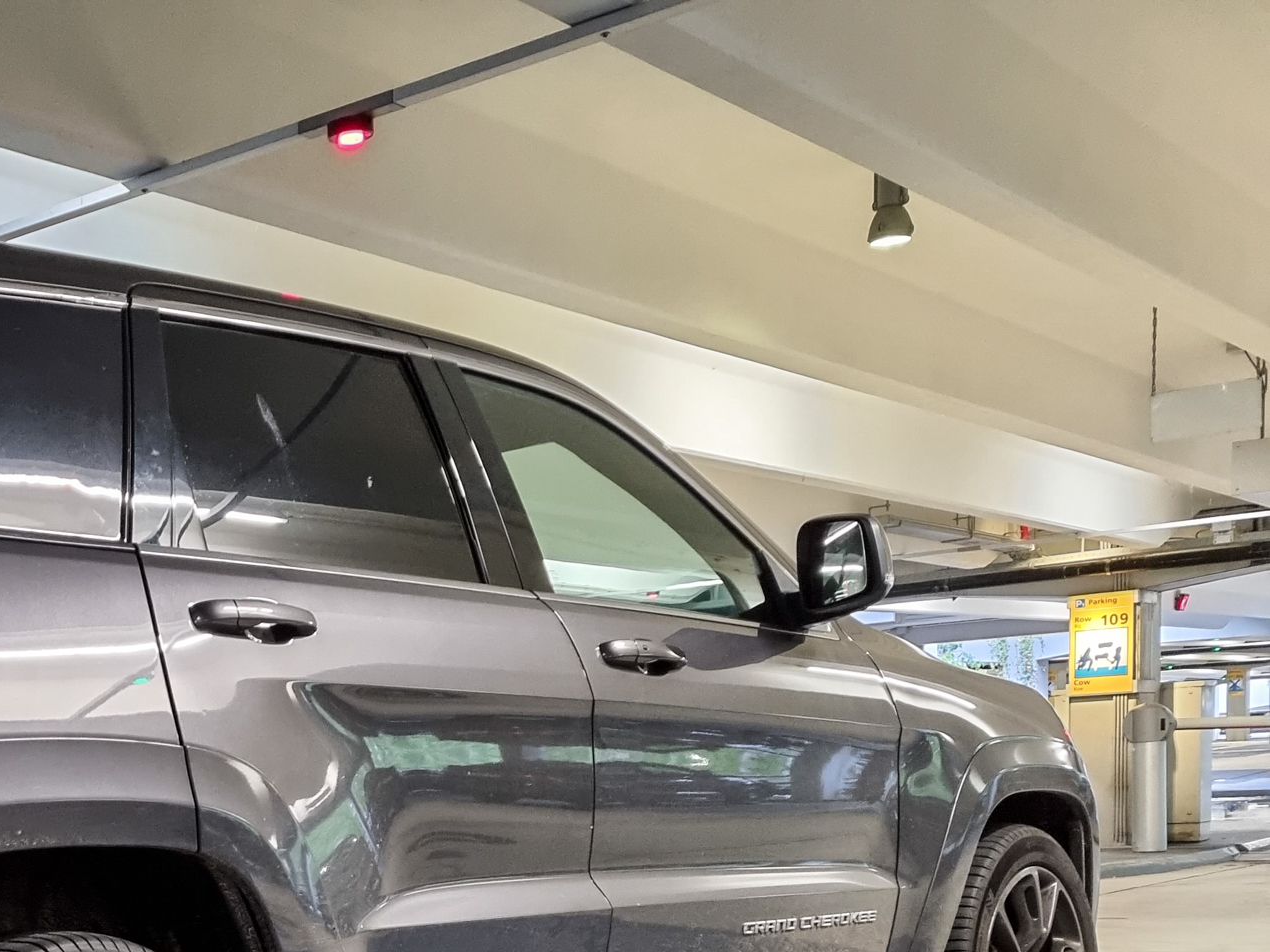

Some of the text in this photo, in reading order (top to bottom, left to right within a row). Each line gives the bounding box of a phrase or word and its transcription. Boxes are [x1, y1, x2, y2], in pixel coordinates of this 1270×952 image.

[1088, 597, 1118, 605] Parking
[1101, 612, 1129, 626] 109
[743, 910, 877, 935] GRAND CHEROKEE
